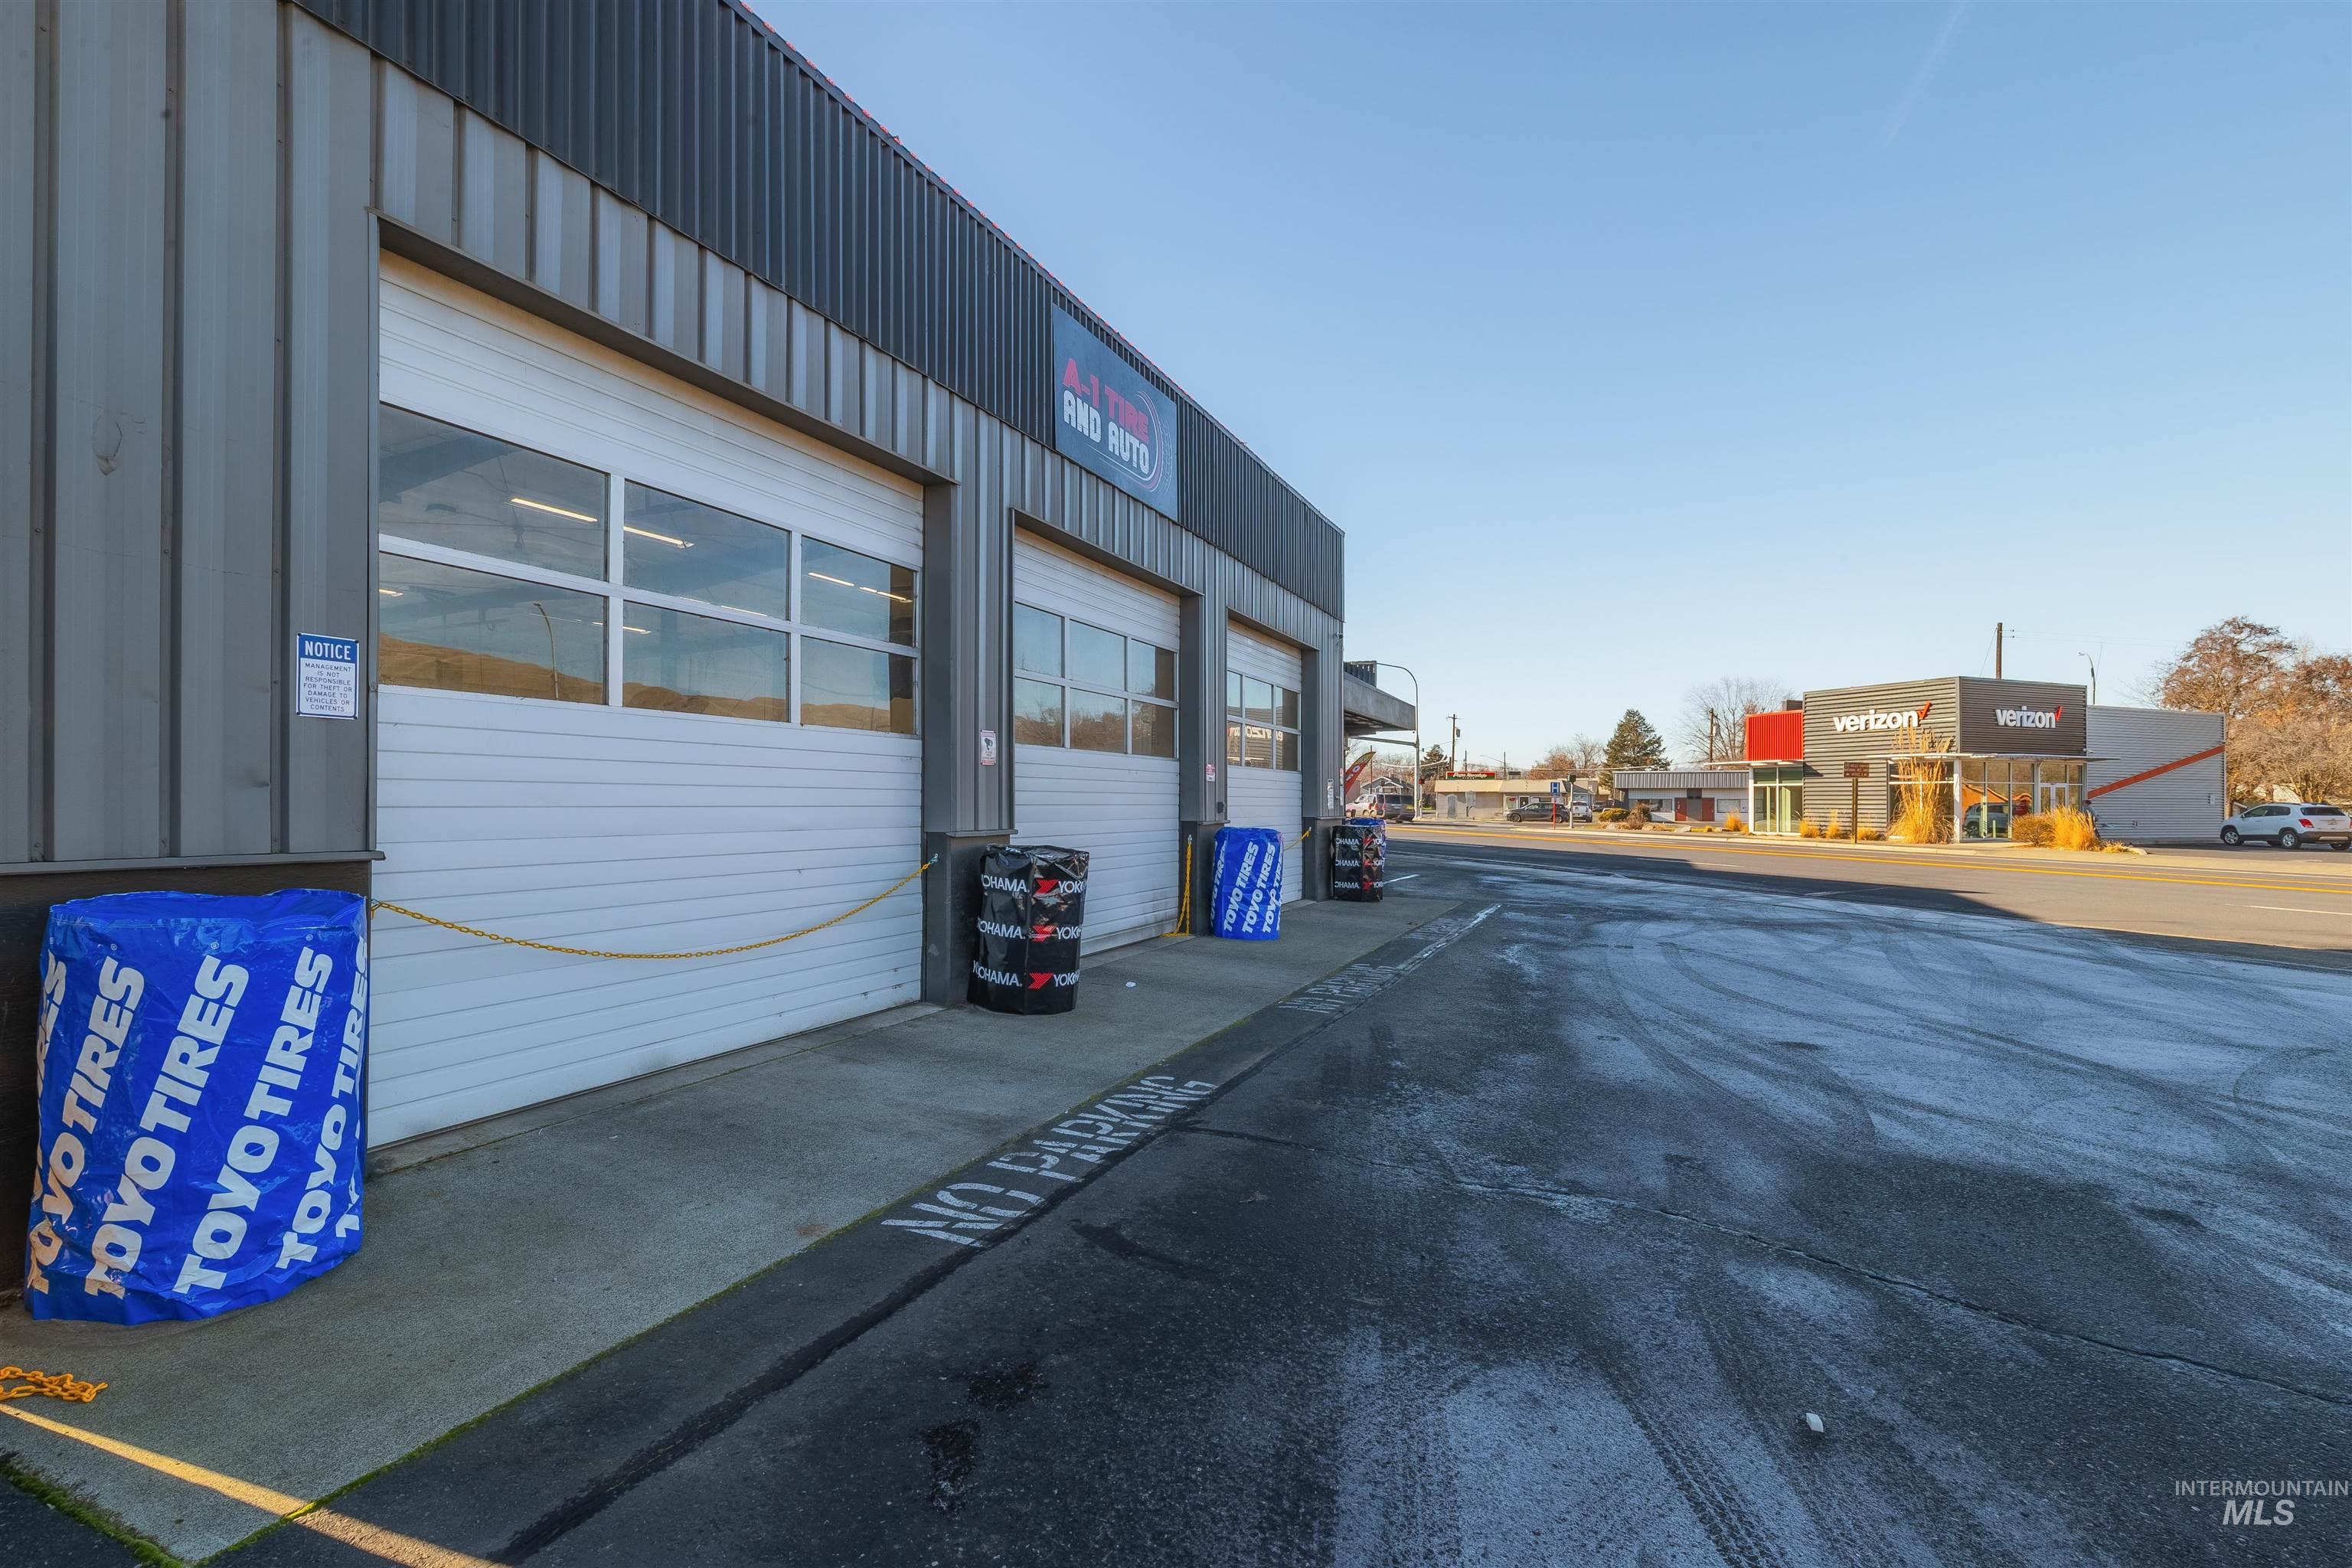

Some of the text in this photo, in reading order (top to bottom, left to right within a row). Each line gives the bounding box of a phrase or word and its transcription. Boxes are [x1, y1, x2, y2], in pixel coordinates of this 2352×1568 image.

[1063, 358, 1149, 443] A-1 TIRE
[1063, 390, 1149, 475] AND AUTO
[305, 640, 351, 660] NOTICE
[305, 662, 351, 672] MANAGEMENT
[305, 676, 351, 685] RESPONSIBLE
[1833, 709, 1919, 732] verizon
[1995, 706, 2056, 728] verizon
[1551, 782, 1560, 794] H
[1223, 841, 1259, 932] TOYO TIRES
[1242, 842, 1276, 934] TOYO TIRES
[27, 956, 145, 1295] TOYO TIRES
[84, 954, 250, 1300] TOYO TIRES
[173, 946, 333, 1294] TOYO TIRES
[880, 1075, 1220, 1247] NO PARKING
[276, 1104, 347, 1269] TOYO
